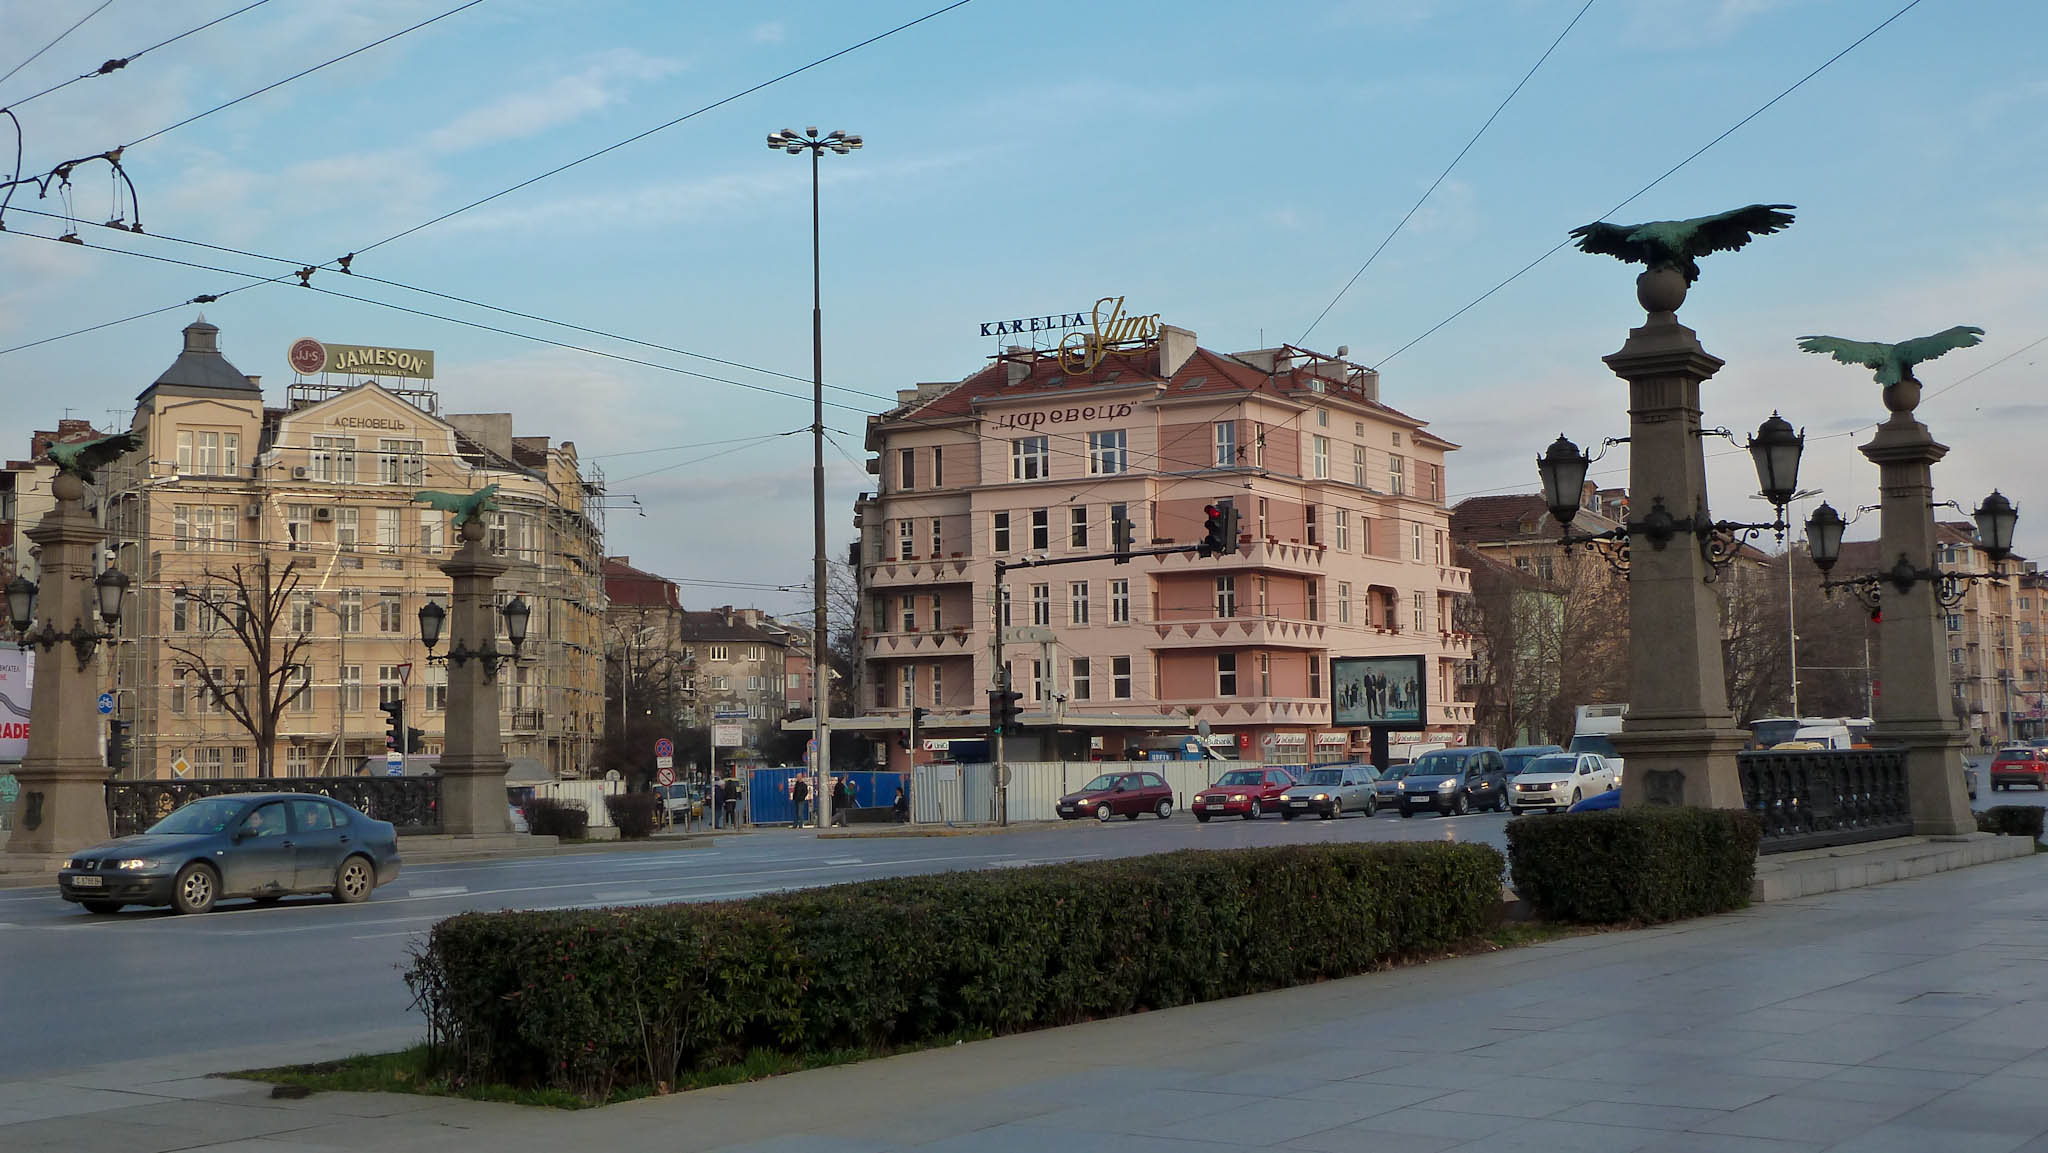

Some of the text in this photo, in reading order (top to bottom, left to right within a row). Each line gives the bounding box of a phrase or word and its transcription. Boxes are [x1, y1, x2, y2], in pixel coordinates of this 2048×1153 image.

[980, 312, 1085, 337] KARELIA
[1058, 296, 1166, 376] Slims
[335, 349, 424, 374] JAMESON
